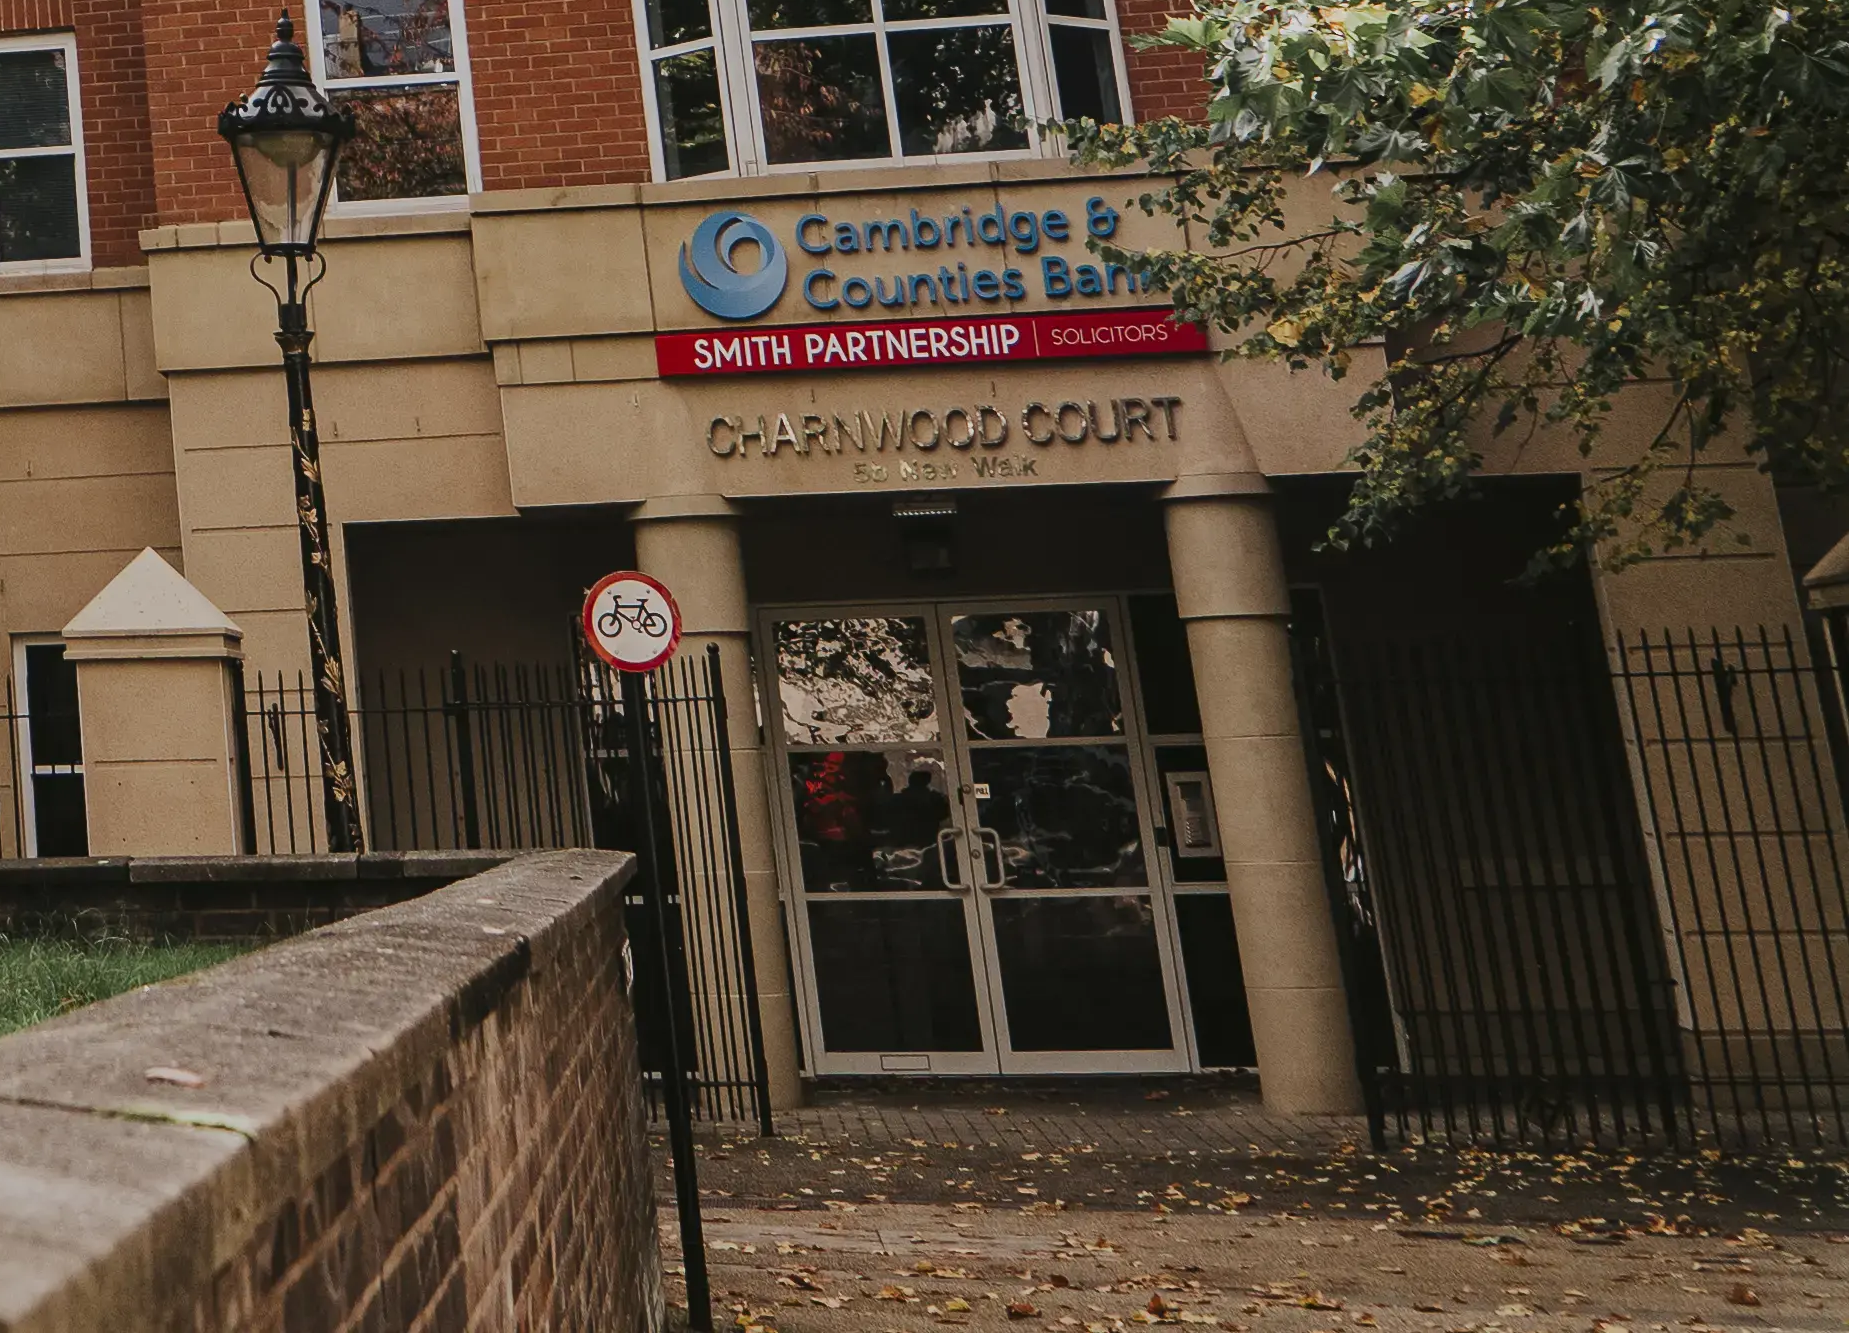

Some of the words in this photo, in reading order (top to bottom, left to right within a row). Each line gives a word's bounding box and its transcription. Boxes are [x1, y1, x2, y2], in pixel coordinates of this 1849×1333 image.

[795, 202, 1069, 253] Cambridge
[1086, 196, 1119, 237] &
[803, 262, 1026, 308] Counties
[694, 335, 792, 368] SMITH
[805, 323, 1020, 363] PARTNERSHIP
[1051, 324, 1168, 345] SOLICITORS
[707, 405, 1007, 455] CHARNWOOD
[1022, 396, 1182, 441] COURT
[899, 457, 958, 481] New
[970, 453, 1039, 478] Walk
